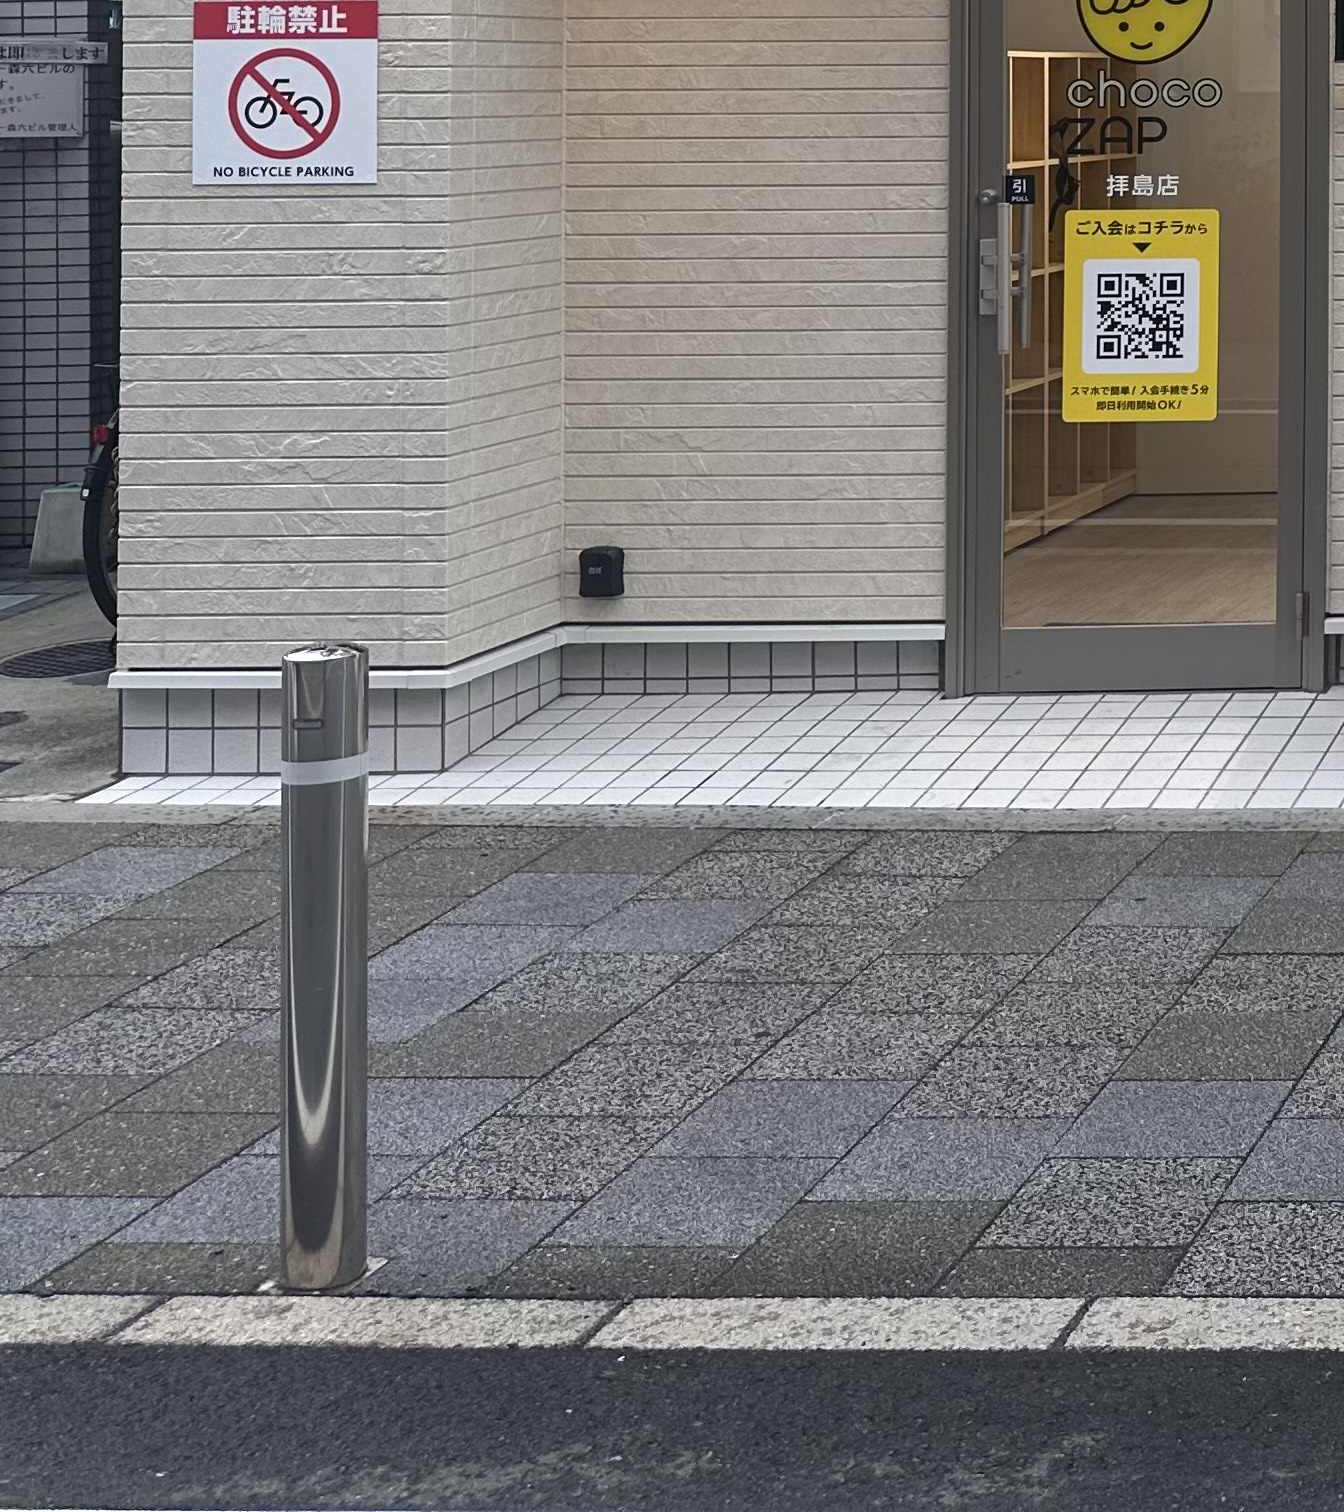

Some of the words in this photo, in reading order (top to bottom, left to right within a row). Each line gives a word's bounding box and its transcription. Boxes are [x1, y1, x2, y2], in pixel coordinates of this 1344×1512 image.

[227, 5, 348, 34] 駐輪禁止
[1066, 69, 1223, 108] choco
[1066, 116, 1168, 155] ZAP
[213, 167, 234, 177] NO
[238, 167, 292, 177] BICYCLE
[296, 166, 354, 177] PARKING
[1012, 178, 1027, 193] 引
[1106, 174, 1180, 197] 拝島店
[1076, 220, 1208, 236] ご入会はコチラから
